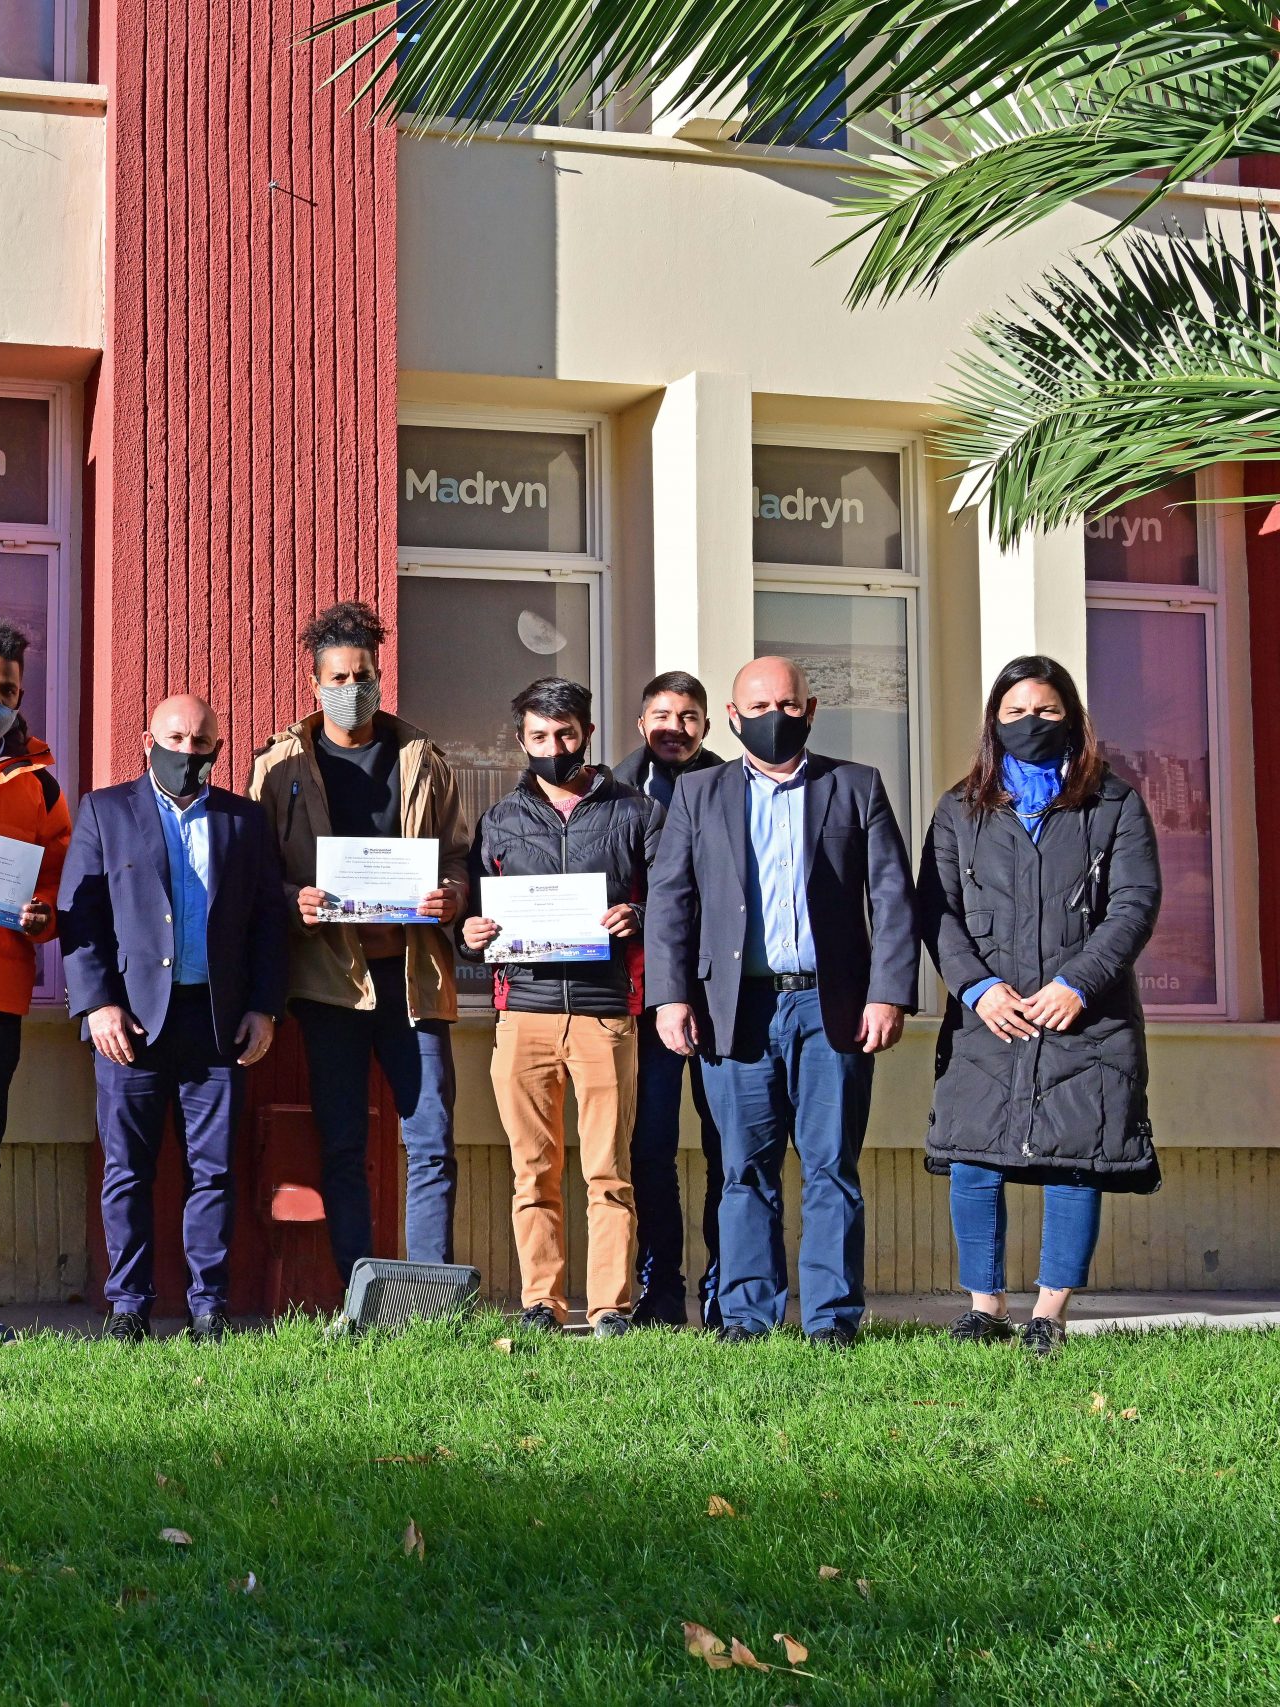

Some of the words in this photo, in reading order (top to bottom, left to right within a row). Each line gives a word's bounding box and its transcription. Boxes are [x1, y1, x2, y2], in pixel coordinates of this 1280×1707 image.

[405, 468, 547, 514] Madryn
[752, 486, 864, 529] adryn
[1138, 972, 1180, 989] inda
